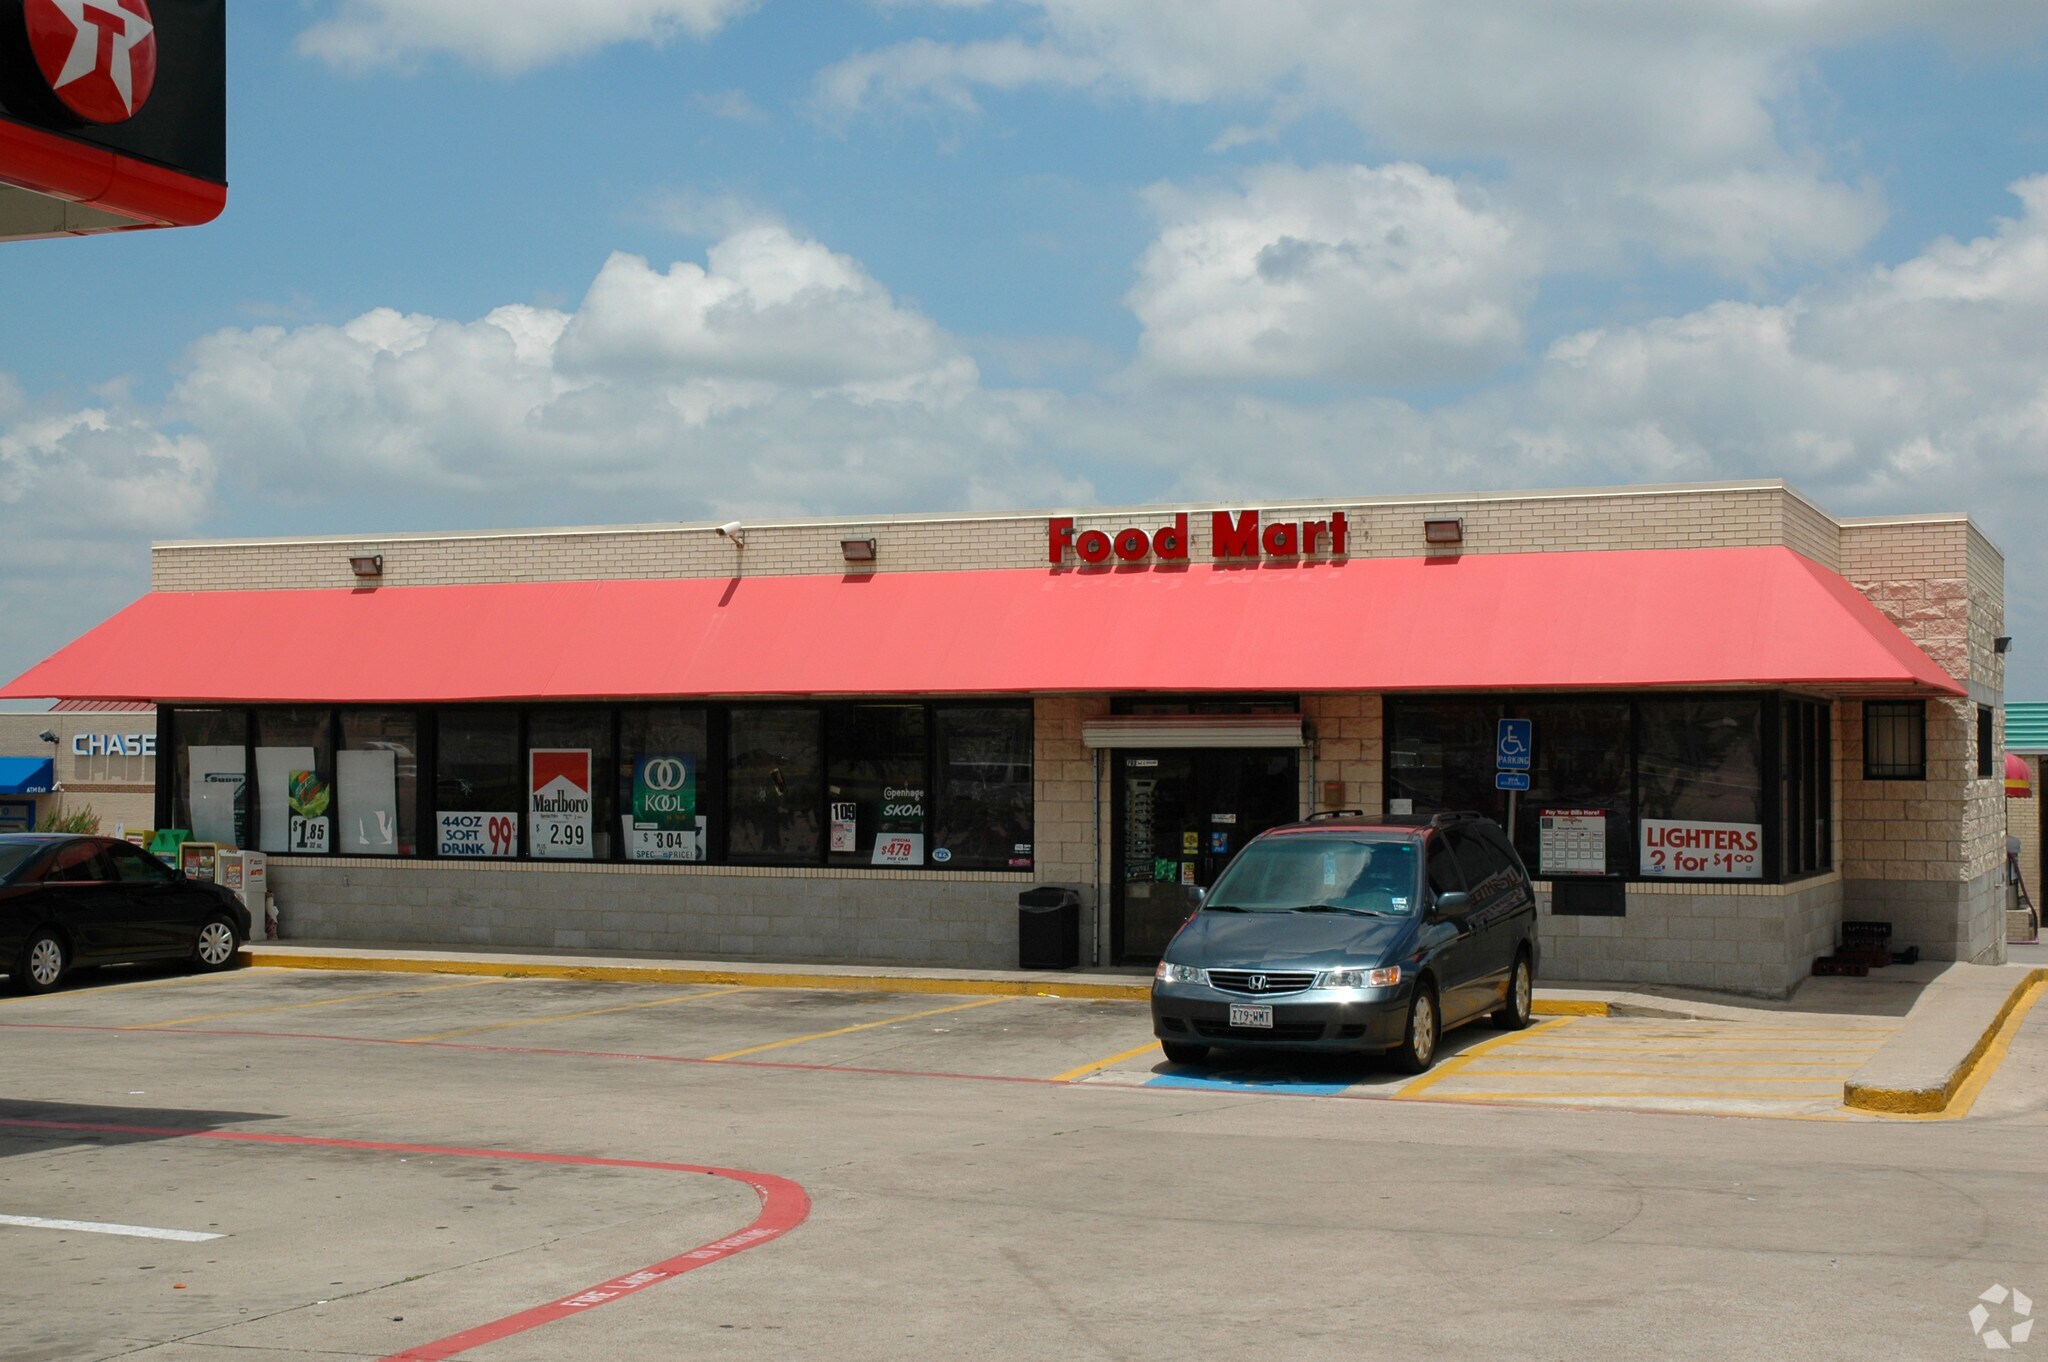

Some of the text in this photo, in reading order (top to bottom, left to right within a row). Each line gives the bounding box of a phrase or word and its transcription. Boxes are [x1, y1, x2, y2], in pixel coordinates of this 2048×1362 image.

[1049, 510, 1348, 563] Food Mart
[72, 733, 157, 756] CHASE
[1498, 755, 1529, 765] PARKING
[532, 789, 589, 813] Marlboro
[645, 794, 685, 812] KOOL
[883, 786, 924, 801] Copenhage
[832, 803, 856, 821] 109
[441, 816, 483, 828] 44OZ
[293, 819, 325, 848] $1.85
[446, 829, 479, 841] SOFT
[550, 823, 584, 845] 2.99
[1646, 826, 1759, 852] LIGHTERS
[441, 843, 486, 855] DRINK
[668, 850, 694, 859] PRICE!
[1673, 851, 1709, 872] for
[560, 1290, 620, 1307] FIRE
[605, 1270, 667, 1289] LANE
